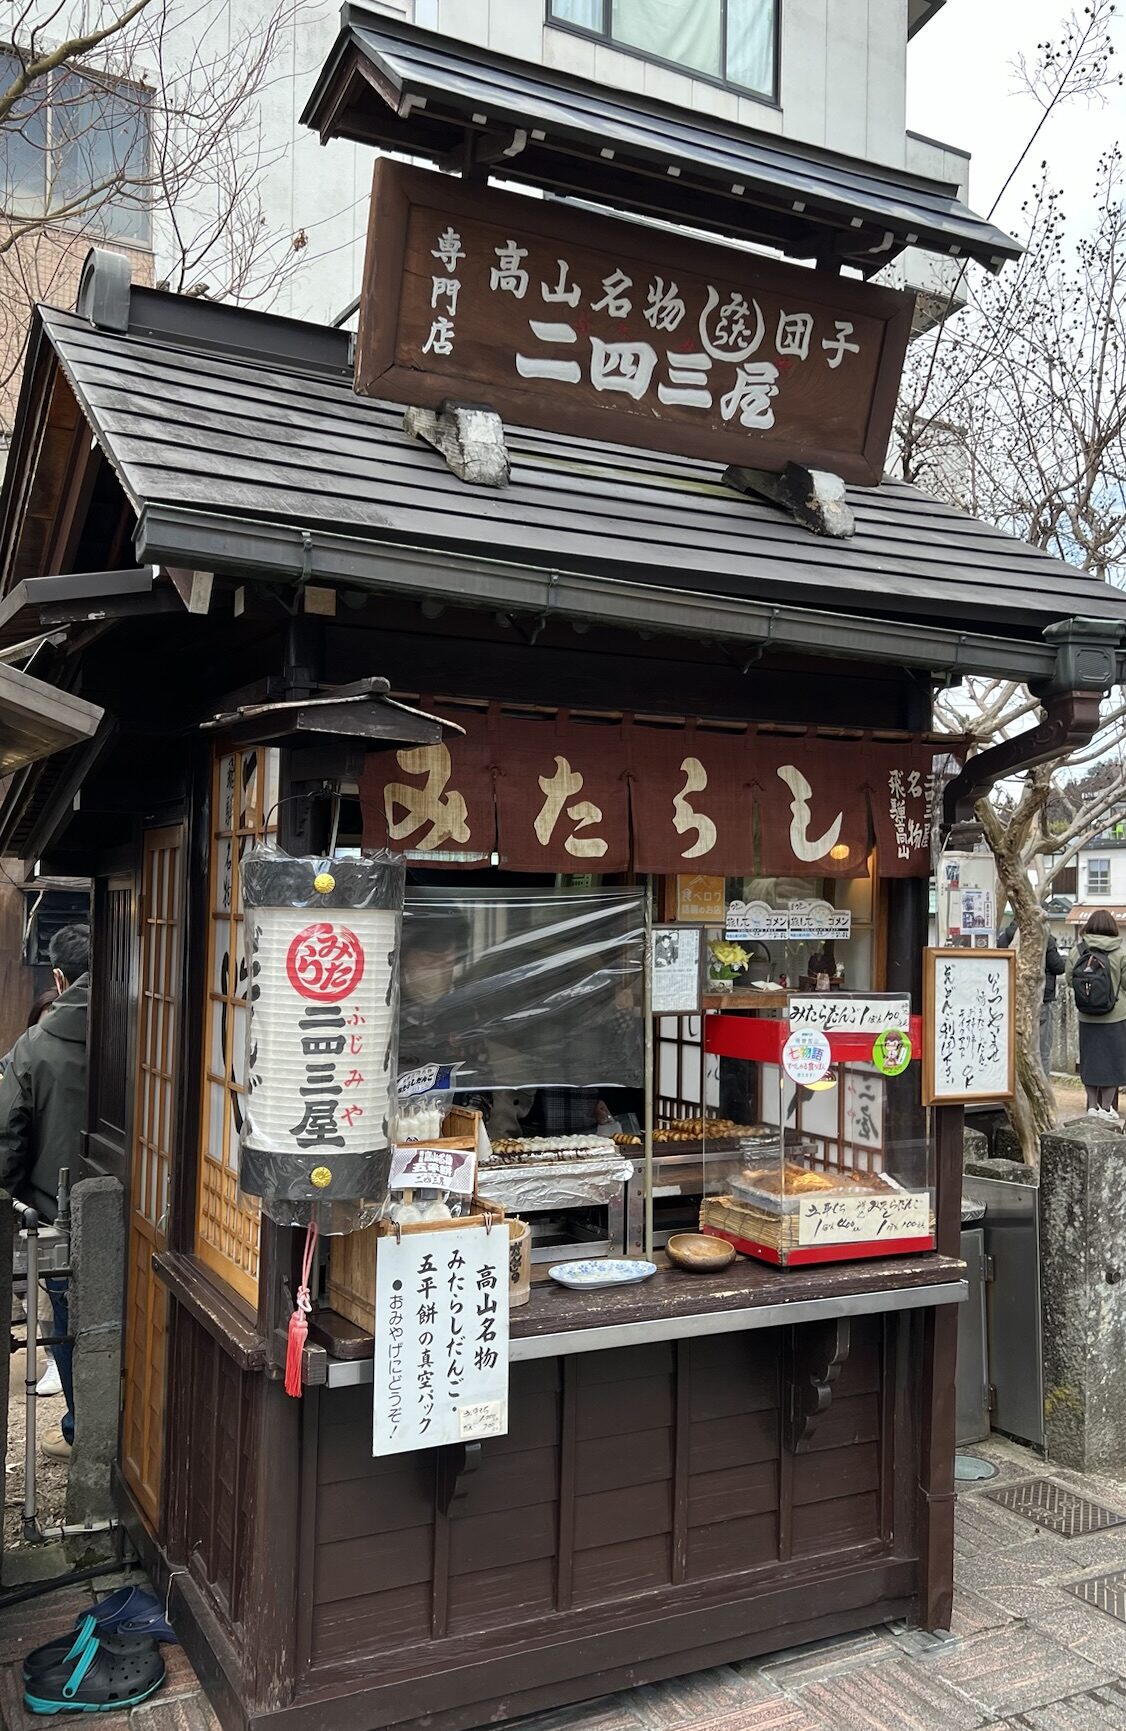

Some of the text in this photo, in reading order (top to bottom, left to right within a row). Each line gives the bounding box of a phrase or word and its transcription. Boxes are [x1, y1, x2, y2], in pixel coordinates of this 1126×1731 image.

[422, 227, 466, 356] 専門店
[515, 319, 779, 430] 二四三屋
[384, 743, 842, 863] みたらし
[288, 1005, 347, 1149] 二四三屋
[341, 1006, 366, 1127] ふじみや
[416, 1253, 438, 1434] 五平餅の真空パック
[474, 1264, 499, 1371] 高山名物
